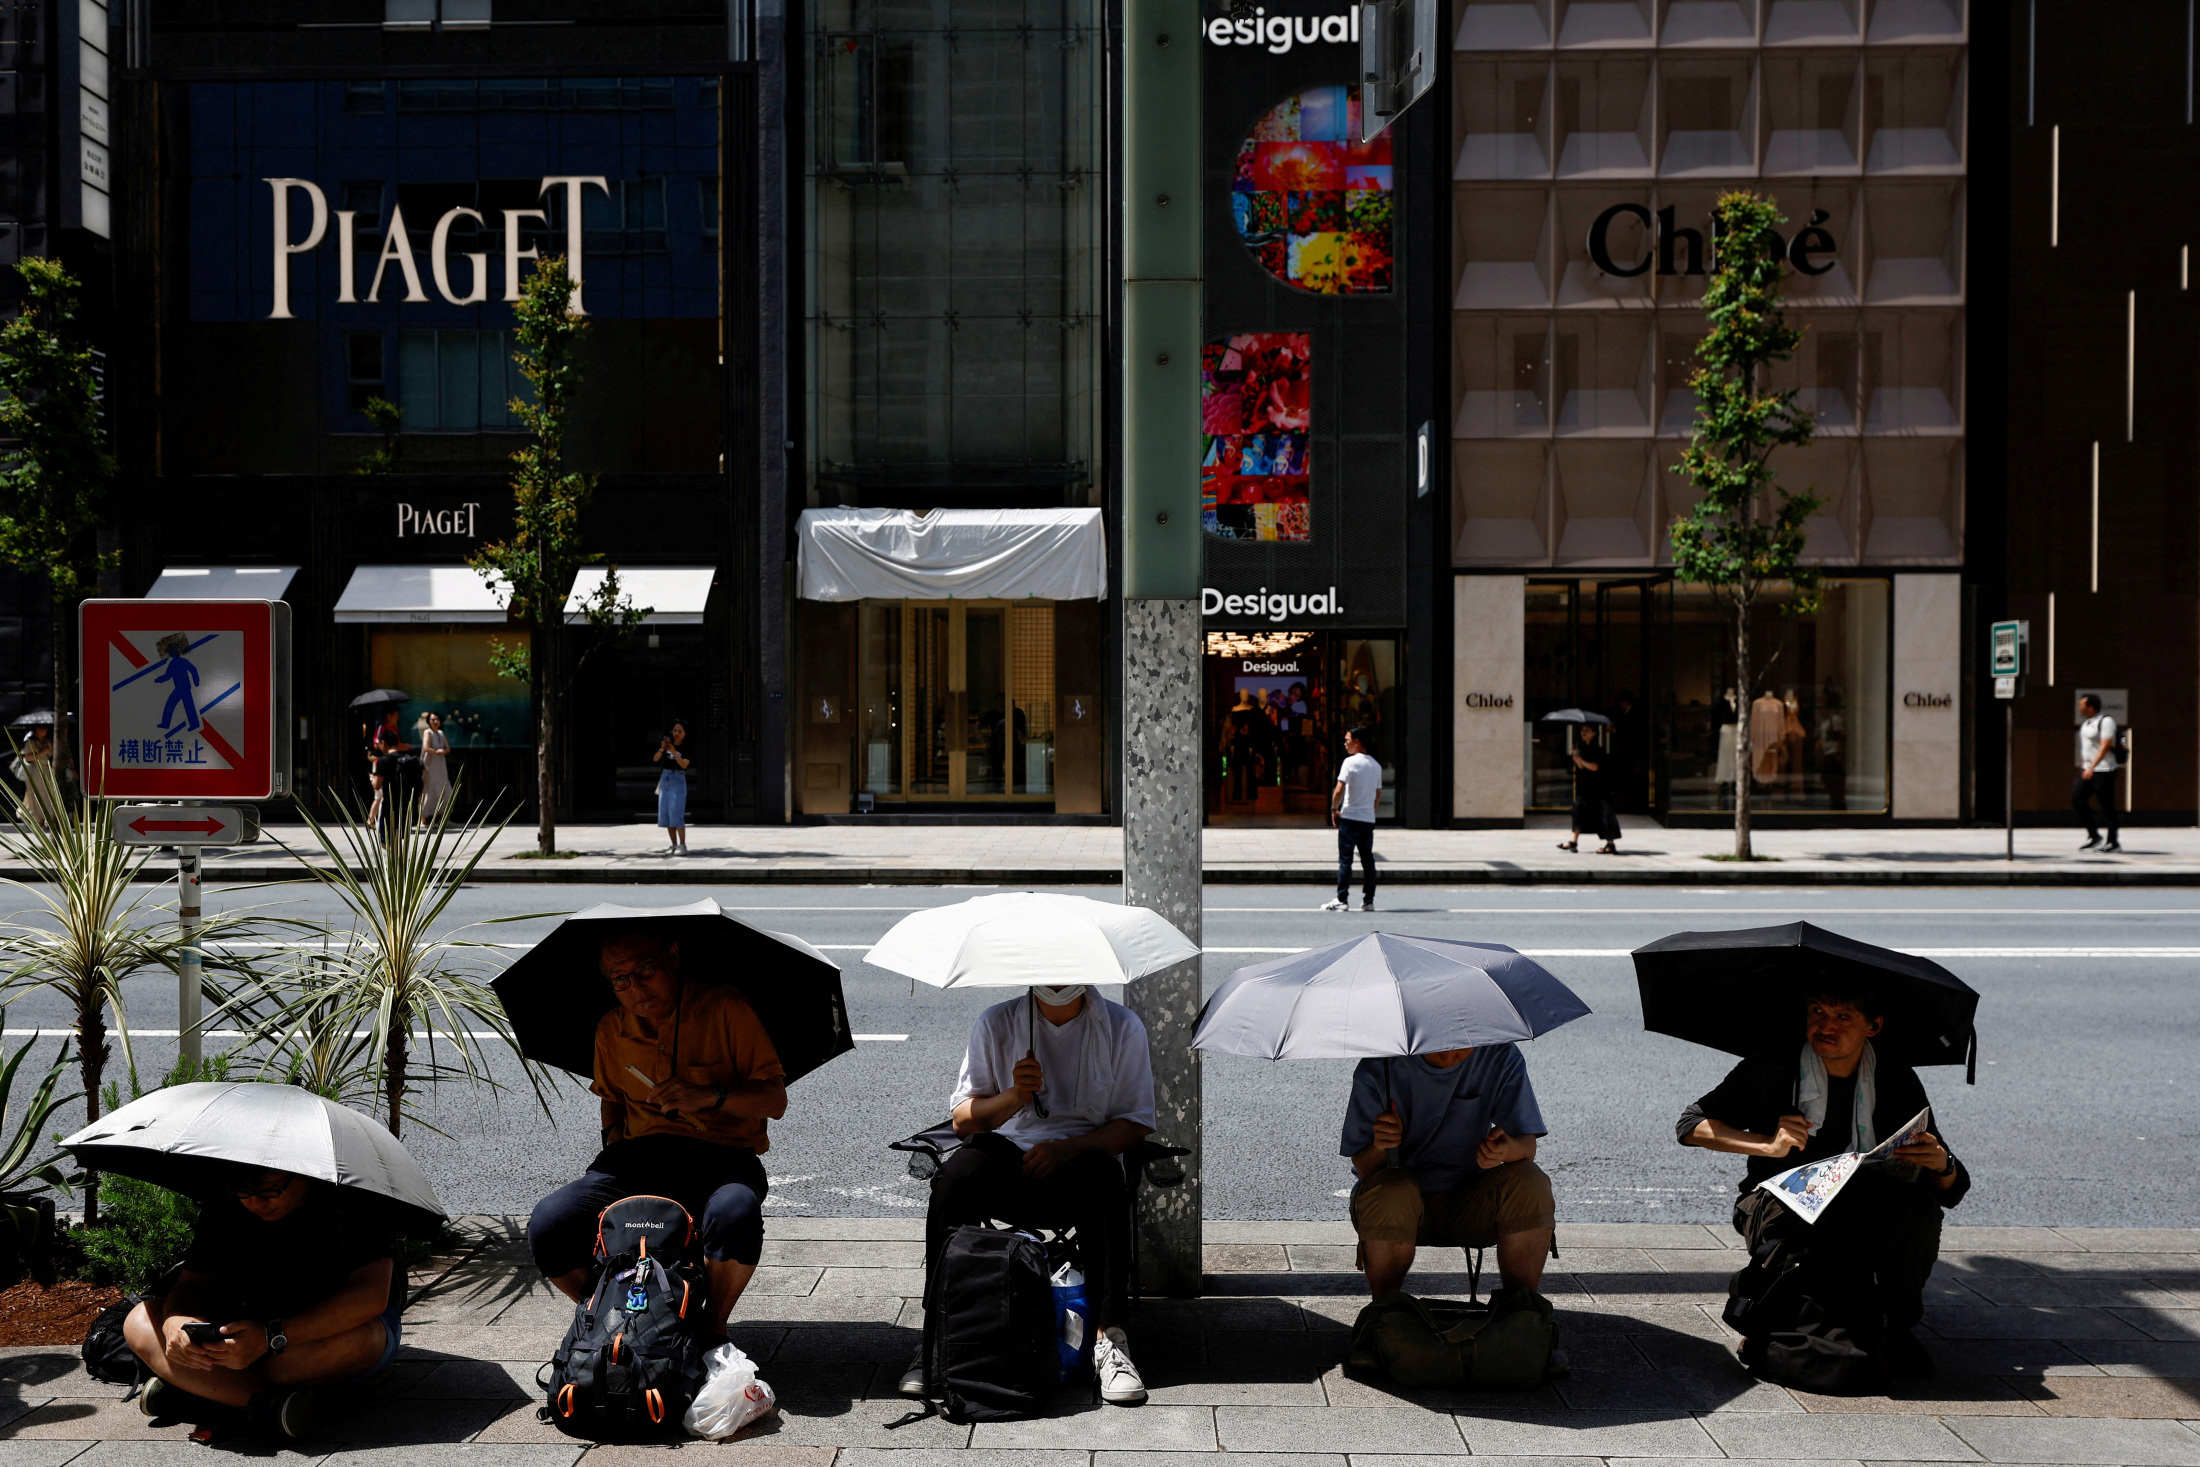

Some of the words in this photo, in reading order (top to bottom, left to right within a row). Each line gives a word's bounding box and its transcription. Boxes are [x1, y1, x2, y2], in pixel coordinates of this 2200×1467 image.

[1202, 5, 1360, 54] esigual
[261, 176, 611, 319] PIAGET
[397, 502, 480, 538] PIAGET
[1201, 586, 1344, 622] Desigual.
[1242, 660, 1300, 675] Desigual.
[1465, 692, 1513, 708] Chloé
[1903, 692, 1952, 708] Chloé
[118, 738, 207, 764] 横断禁止
